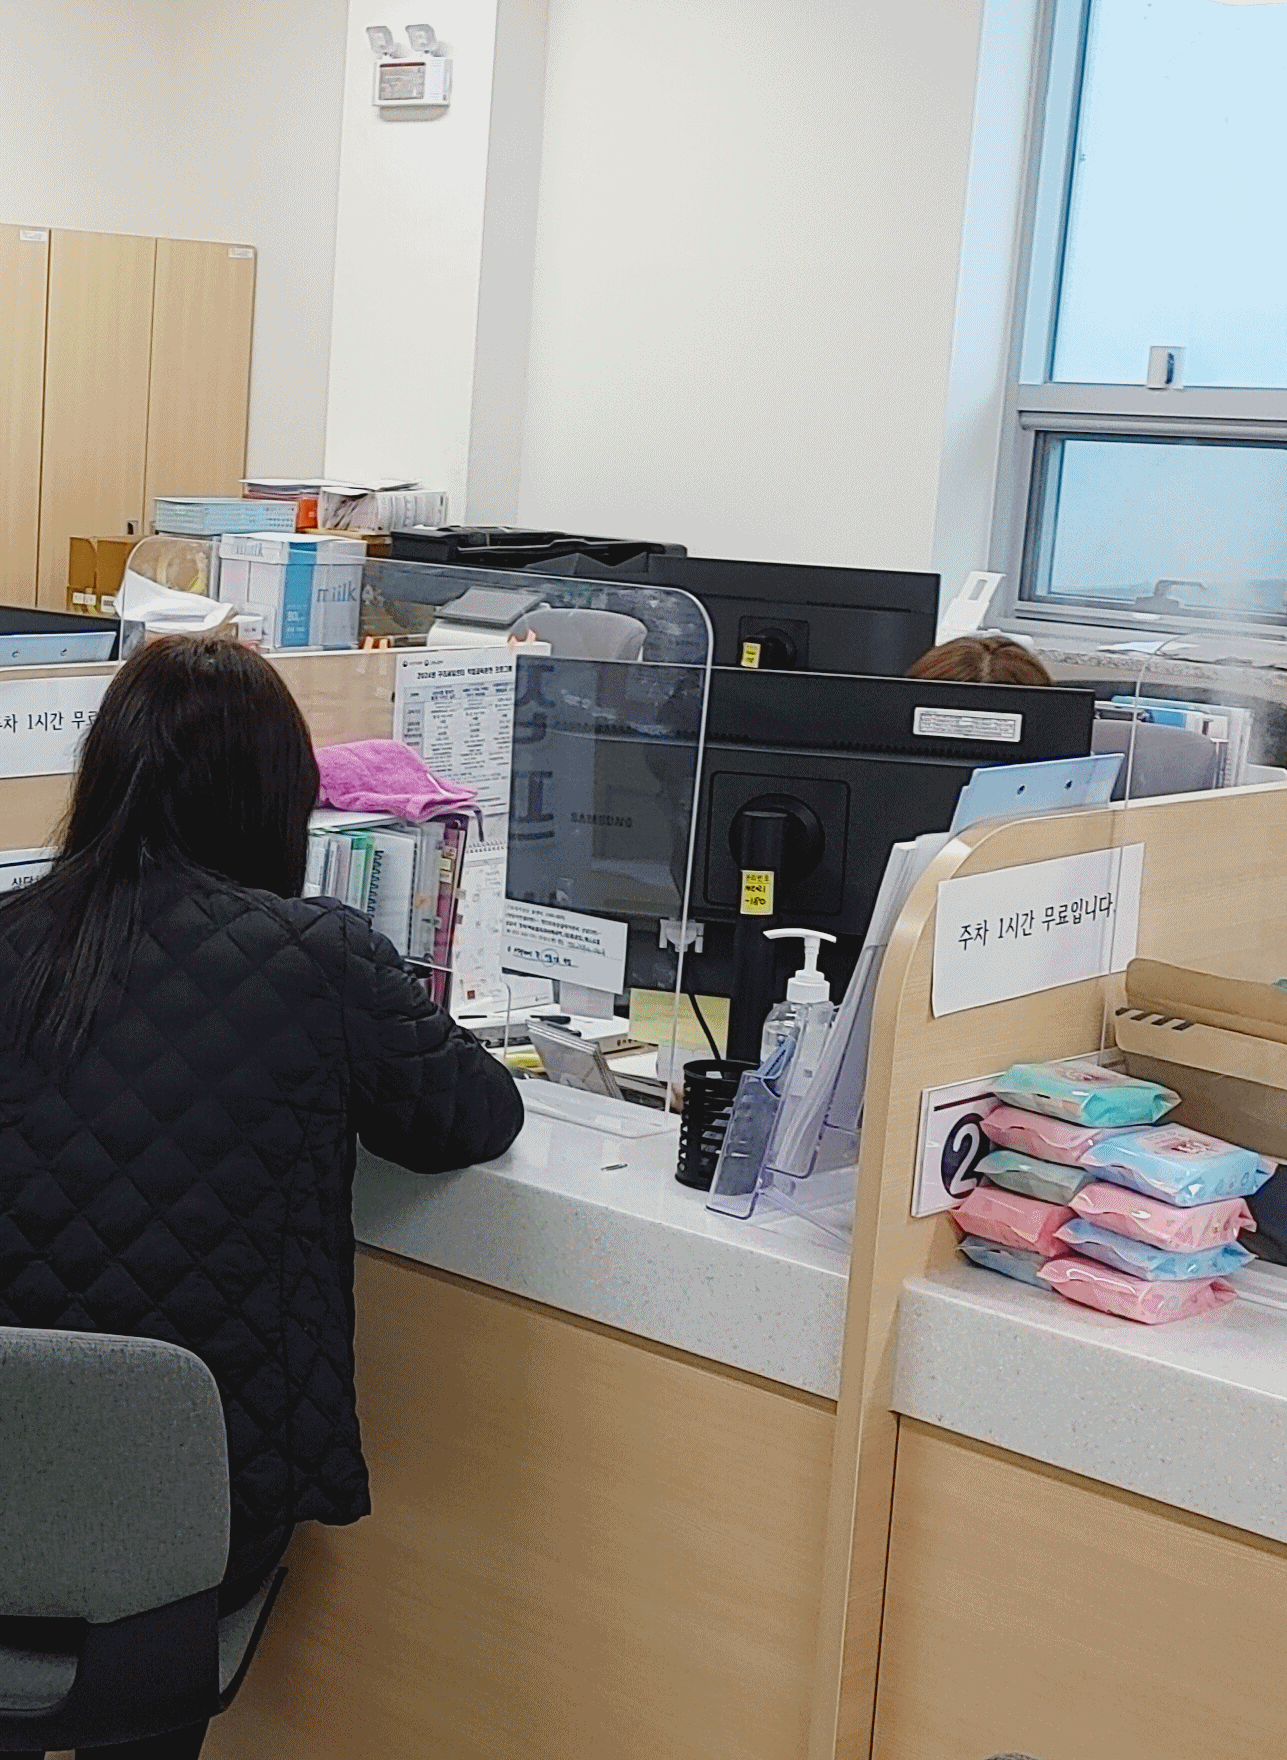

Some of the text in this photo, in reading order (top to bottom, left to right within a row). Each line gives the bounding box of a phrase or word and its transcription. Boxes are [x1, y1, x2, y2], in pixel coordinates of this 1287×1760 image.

[27, 711, 64, 732] 1시간
[570, 811, 632, 828] SAMSUNG
[958, 919, 989, 951] 주차
[997, 909, 1035, 940] 1시간
[949, 1122, 980, 1196] 2
